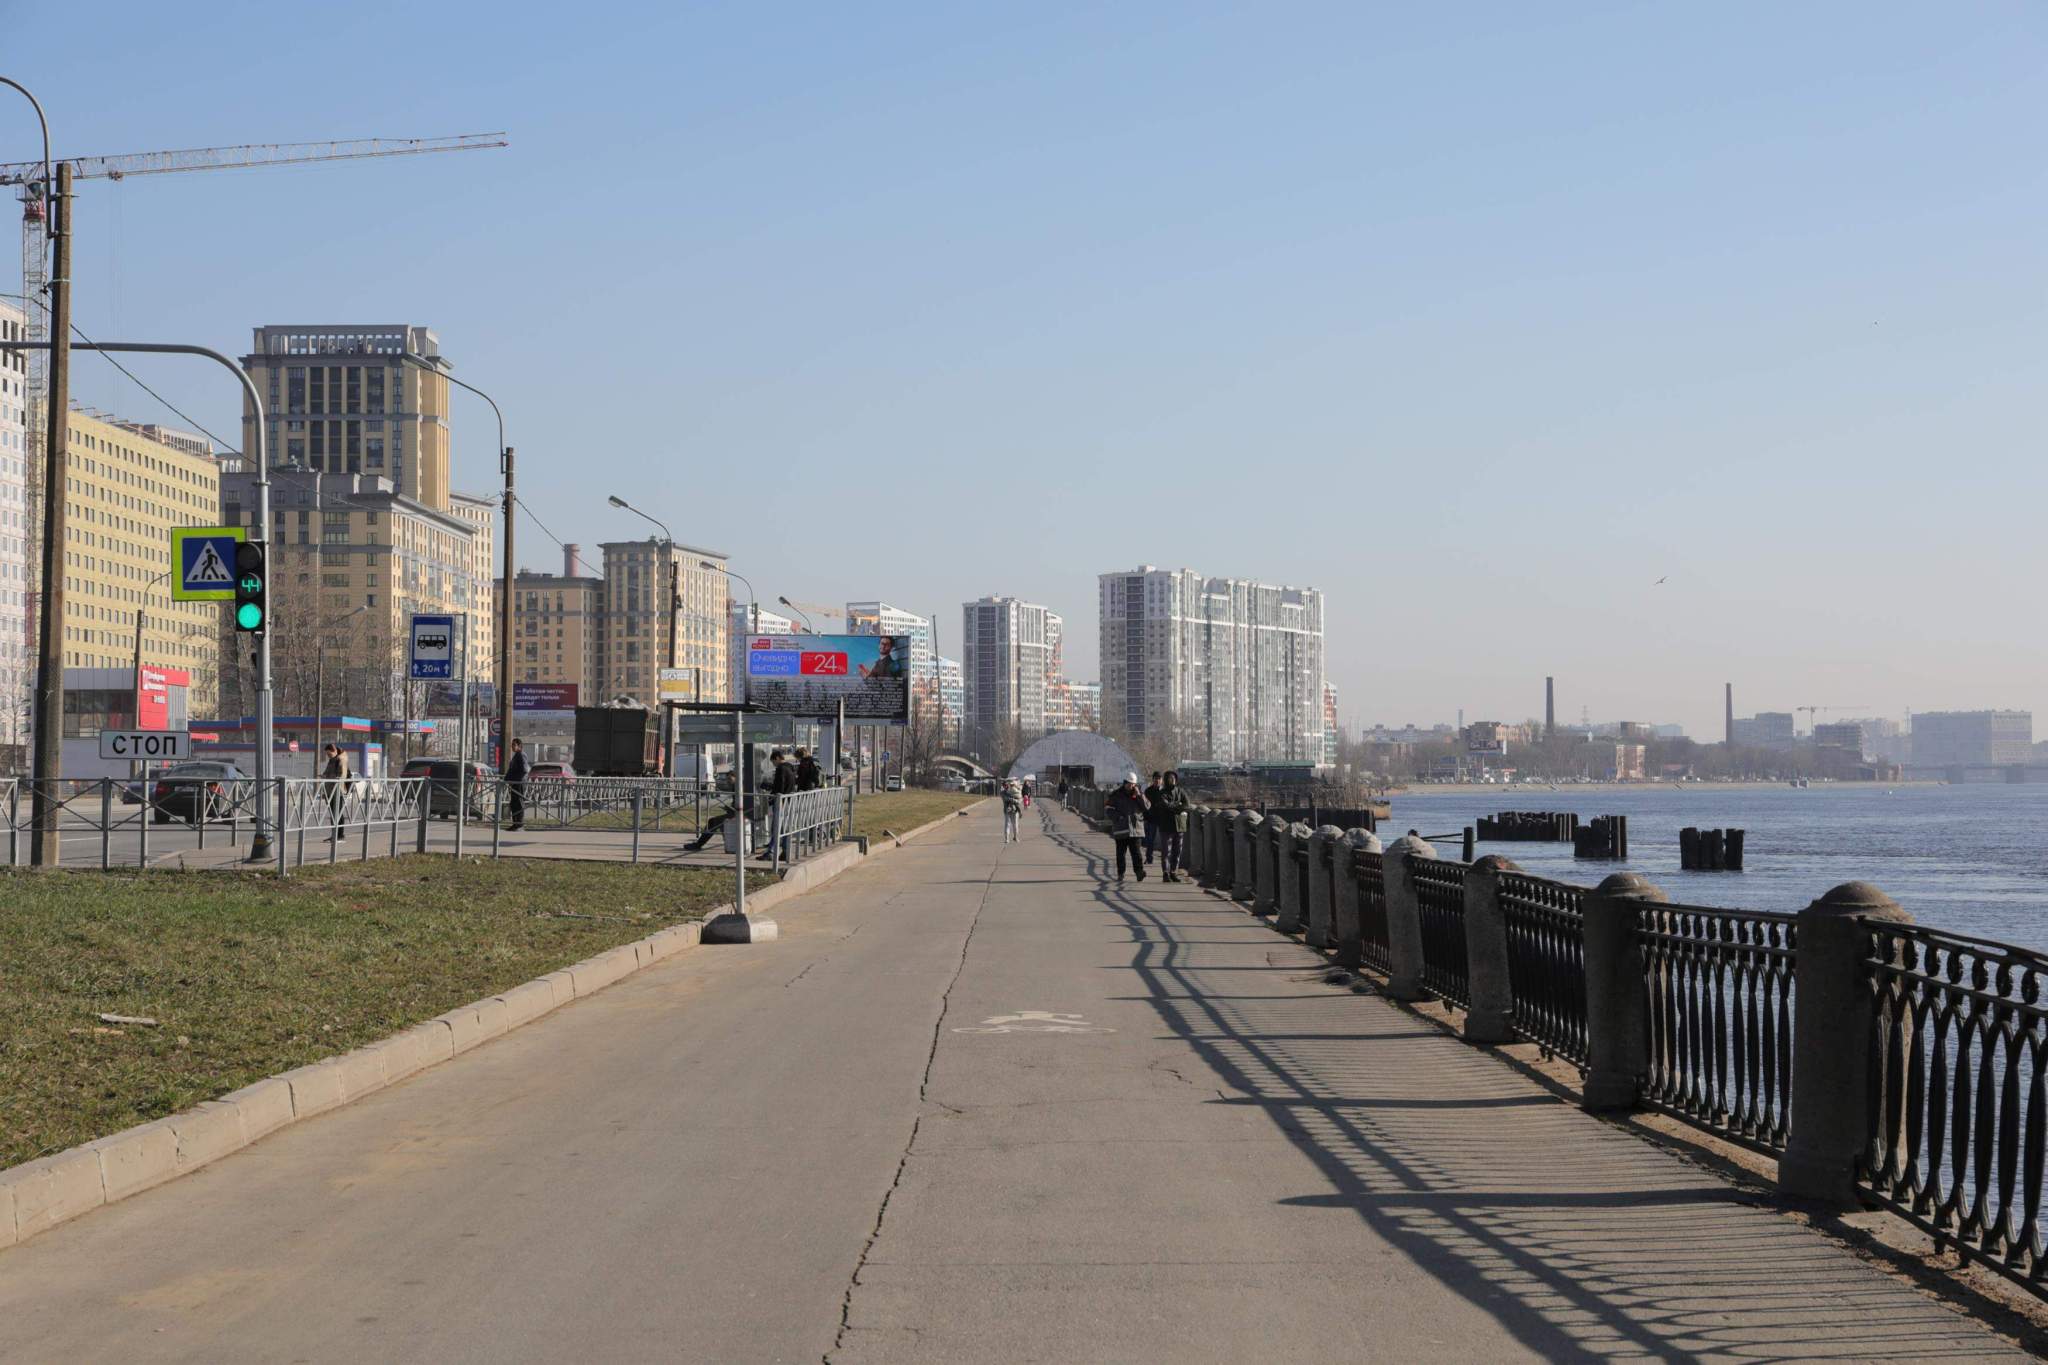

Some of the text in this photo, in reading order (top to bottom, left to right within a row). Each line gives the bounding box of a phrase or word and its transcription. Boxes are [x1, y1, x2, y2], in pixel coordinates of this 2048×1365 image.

[241, 579, 260, 592] 44
[752, 653, 797, 663] Очевидно
[752, 665, 789, 673] выгодно
[112, 735, 176, 755] СТОП
